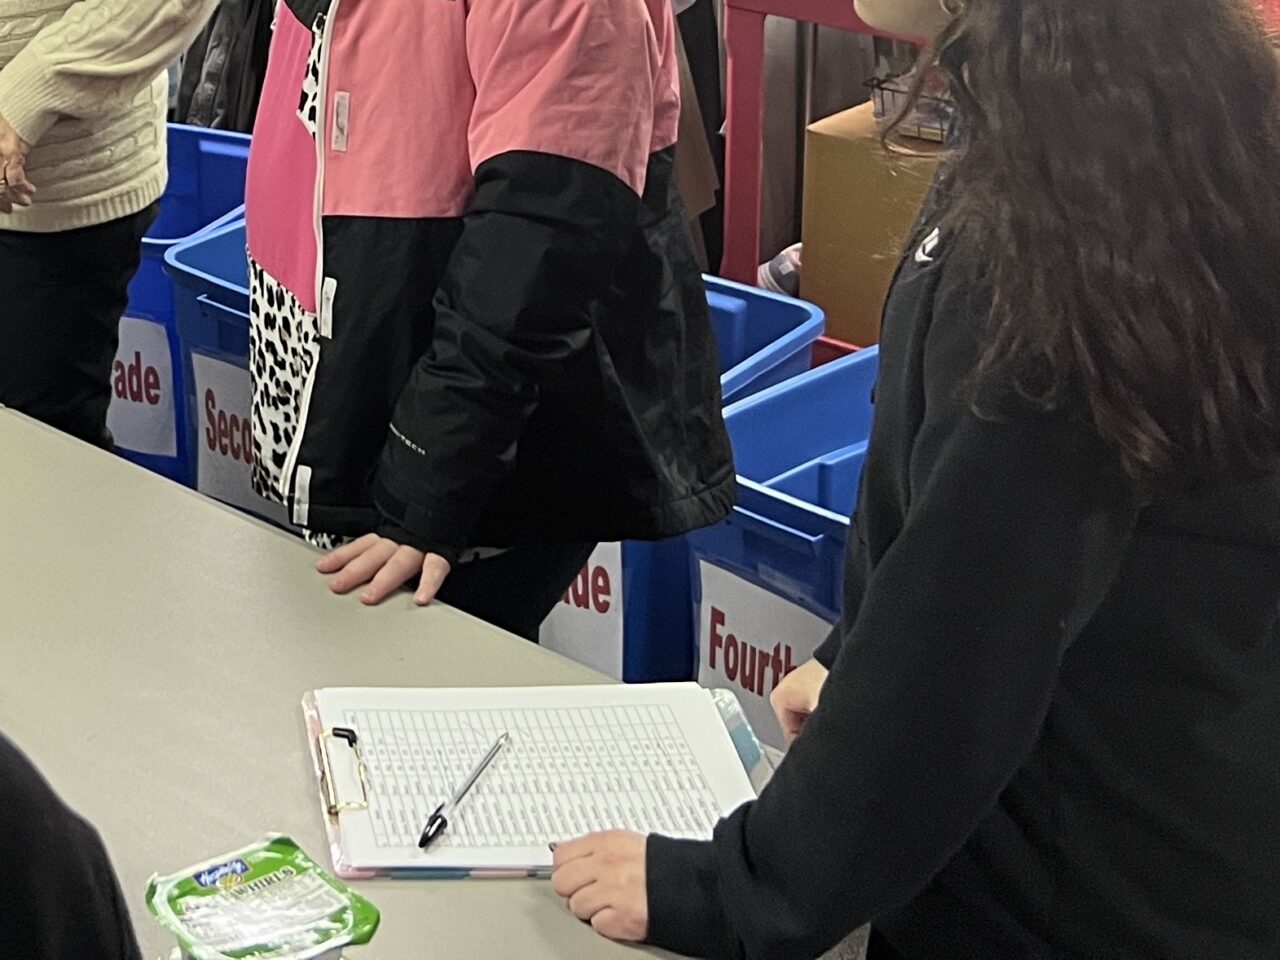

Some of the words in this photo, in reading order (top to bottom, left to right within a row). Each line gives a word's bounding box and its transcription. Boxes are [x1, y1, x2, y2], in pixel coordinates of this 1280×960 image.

[114, 350, 161, 406] ade
[205, 388, 254, 465] Seco
[233, 867, 296, 896] WHIRLS
